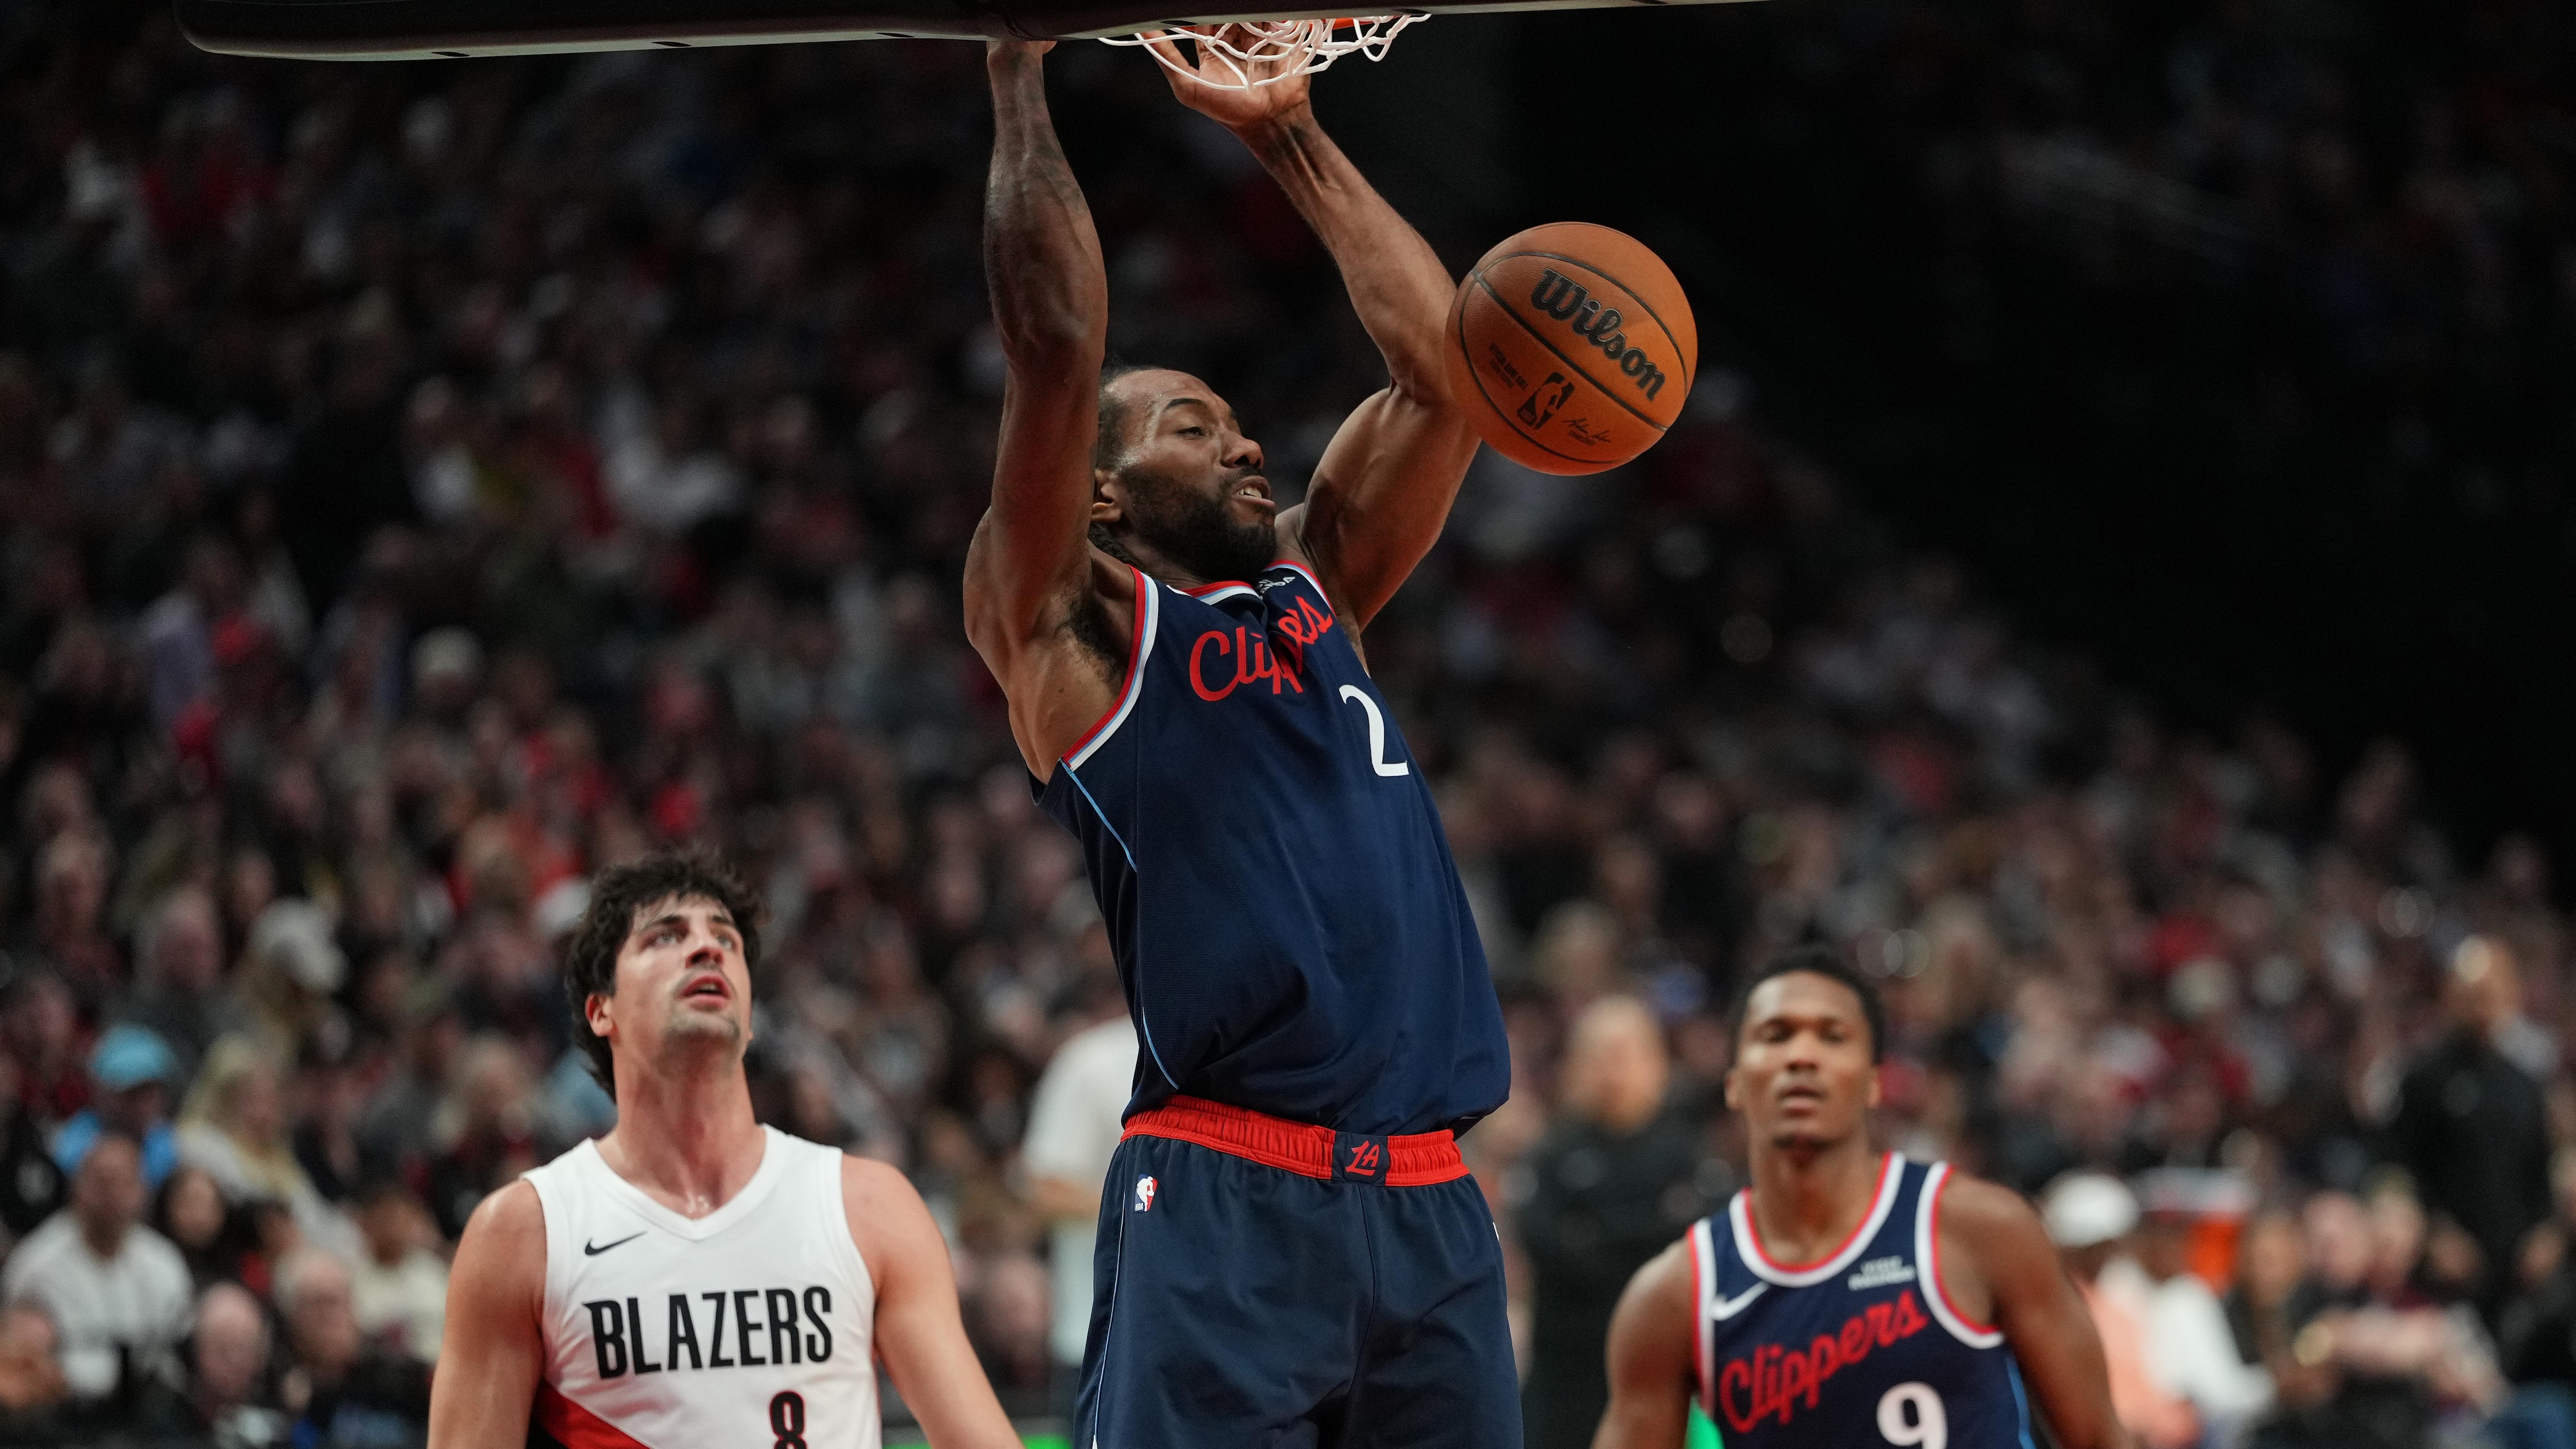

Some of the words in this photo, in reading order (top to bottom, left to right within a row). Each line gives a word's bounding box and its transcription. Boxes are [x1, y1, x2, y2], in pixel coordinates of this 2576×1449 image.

[1531, 268, 1666, 402] Wilson
[1339, 685, 1409, 777] 2
[1345, 1140, 1380, 1177] LA
[1135, 1202, 1144, 1211] NBA
[582, 1286, 833, 1380] BLAZERS
[1720, 1290, 1930, 1434] Clippers
[769, 1391, 808, 1449] 8
[1876, 1381, 1948, 1449] 9
